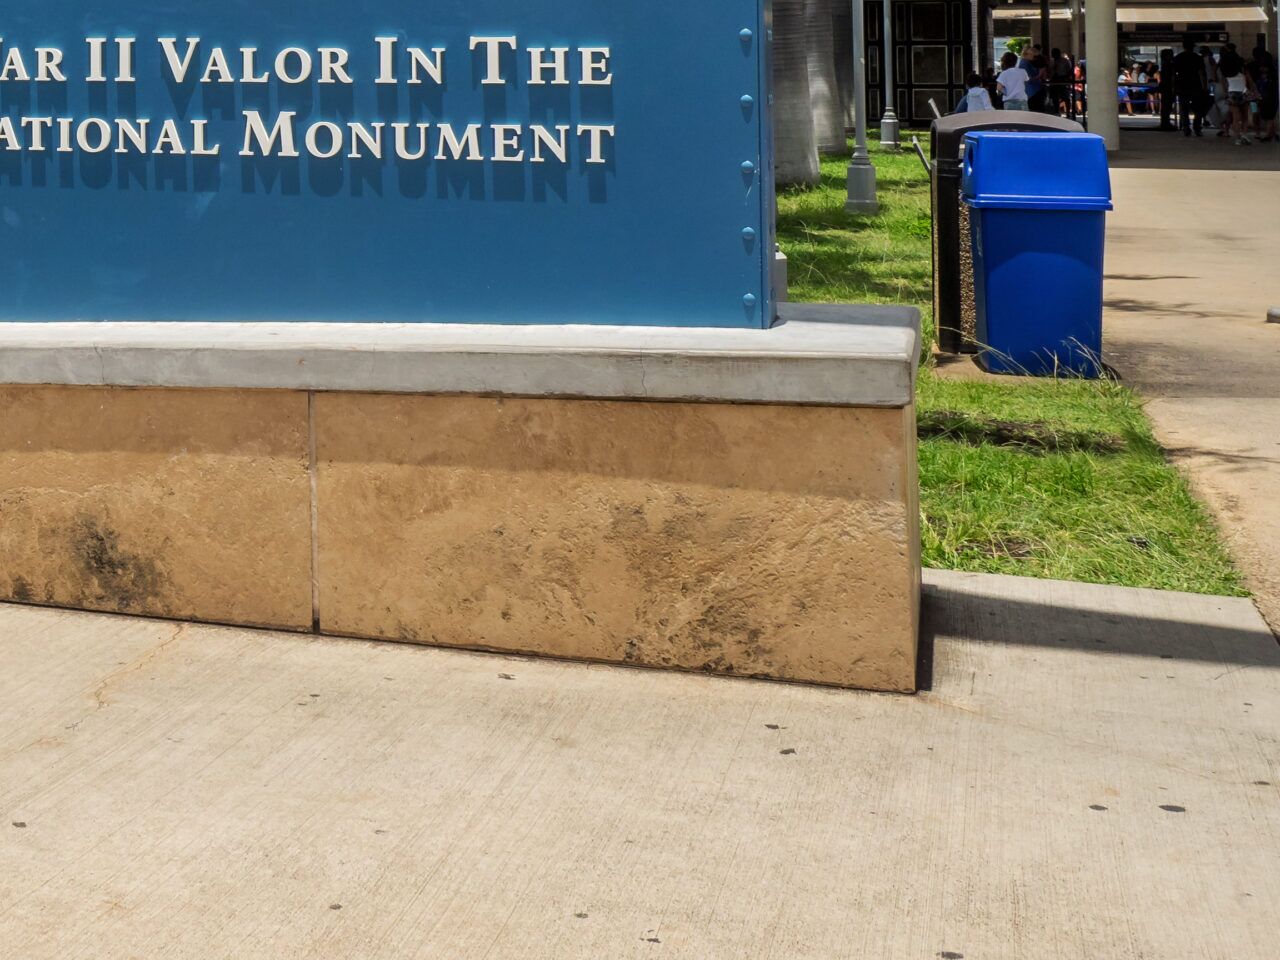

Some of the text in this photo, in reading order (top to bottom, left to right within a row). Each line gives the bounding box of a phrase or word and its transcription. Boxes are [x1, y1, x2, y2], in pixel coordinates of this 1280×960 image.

[86, 37, 136, 82] II
[158, 37, 354, 84] VALOR
[375, 36, 446, 85] IN
[470, 35, 613, 85] THE
[239, 110, 615, 163] MONUMENT
